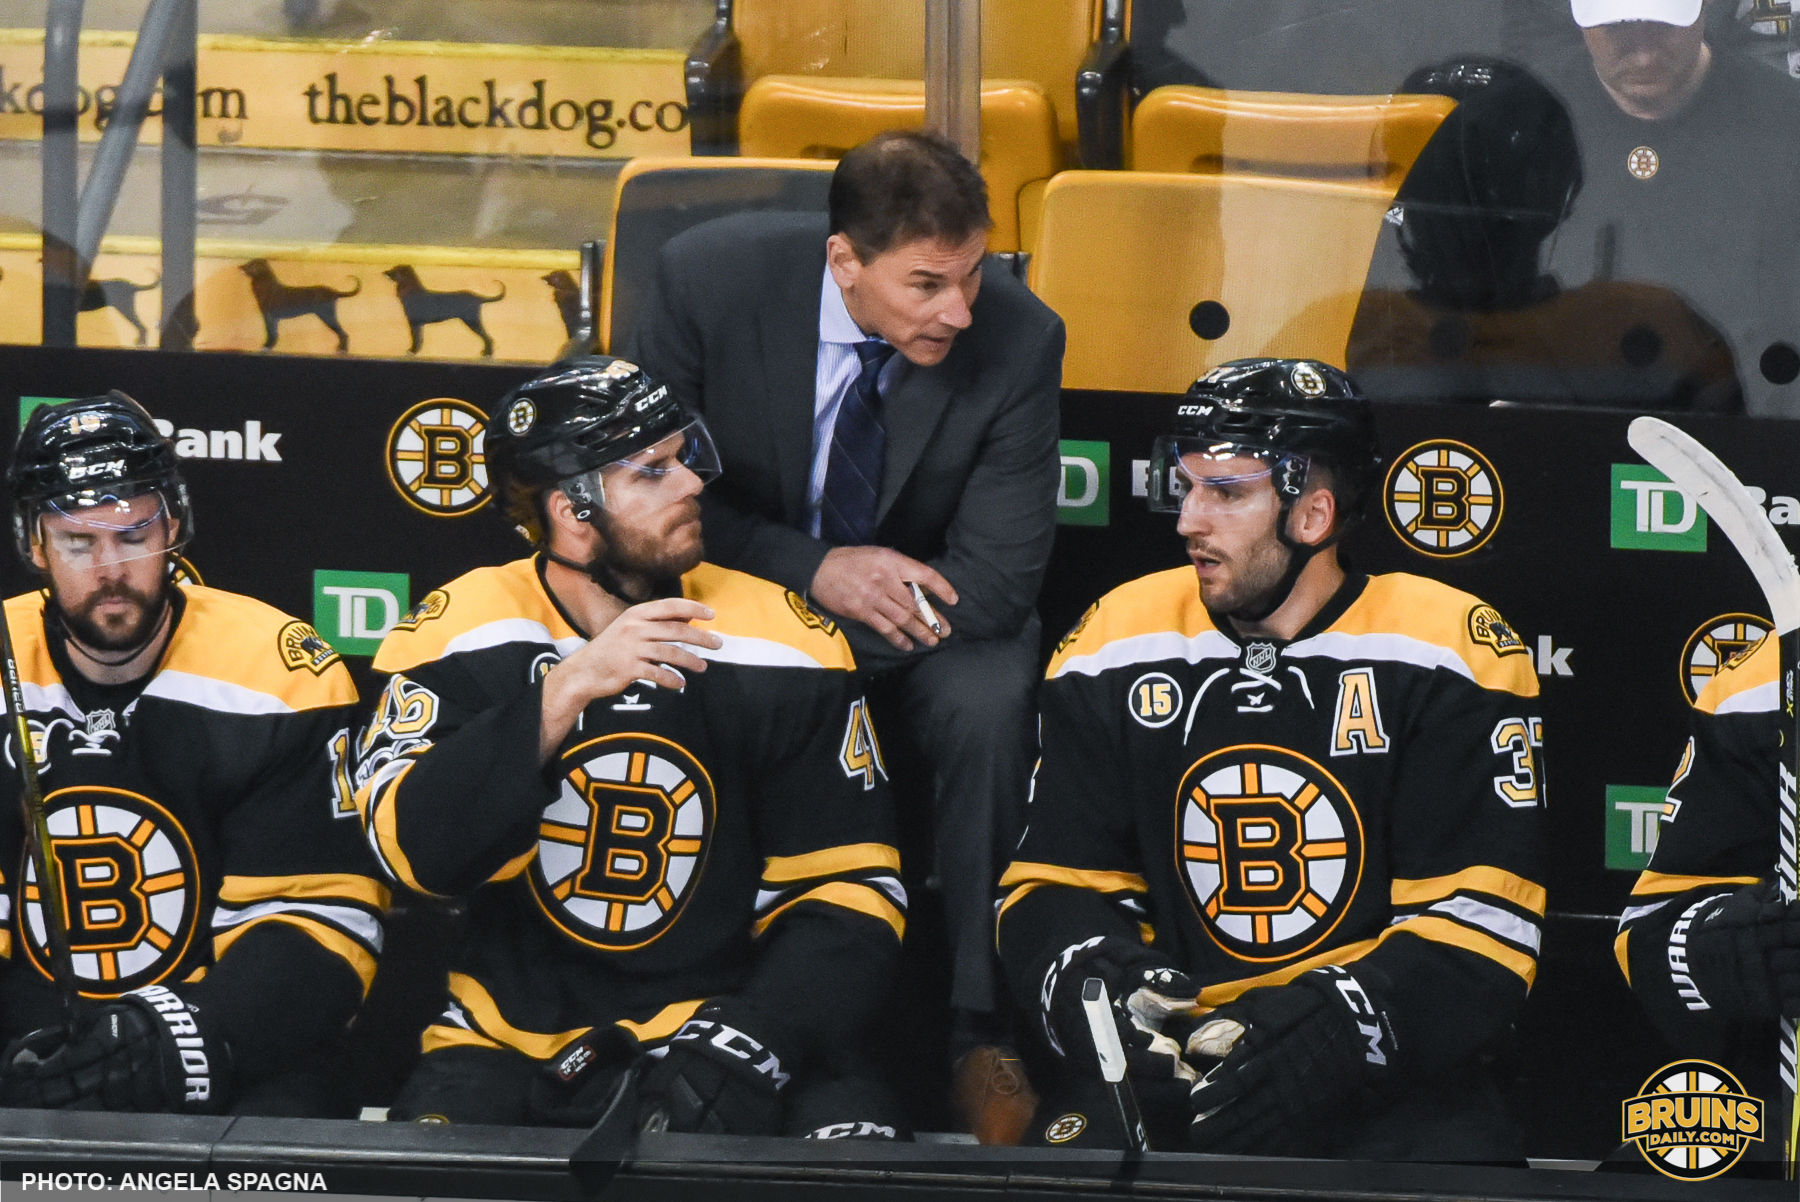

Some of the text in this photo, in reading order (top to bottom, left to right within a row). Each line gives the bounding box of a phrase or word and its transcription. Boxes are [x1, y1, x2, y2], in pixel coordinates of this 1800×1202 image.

[634, 385, 668, 412] CCM
[1177, 405, 1214, 416] CCM
[1057, 456, 1099, 507] D
[1621, 481, 1696, 533] TD
[323, 586, 399, 639] TD
[1253, 649, 1272, 667] NHL
[1139, 683, 1172, 716] 15
[1330, 667, 1391, 756] A
[839, 695, 889, 791] 4
[574, 781, 676, 902] B
[1209, 795, 1306, 912] B
[50, 836, 151, 951] B
[118, 984, 210, 1101] ARRIOR
[560, 1046, 583, 1069] CCM
[671, 1020, 791, 1090] CCM
[804, 1121, 897, 1140] CM
